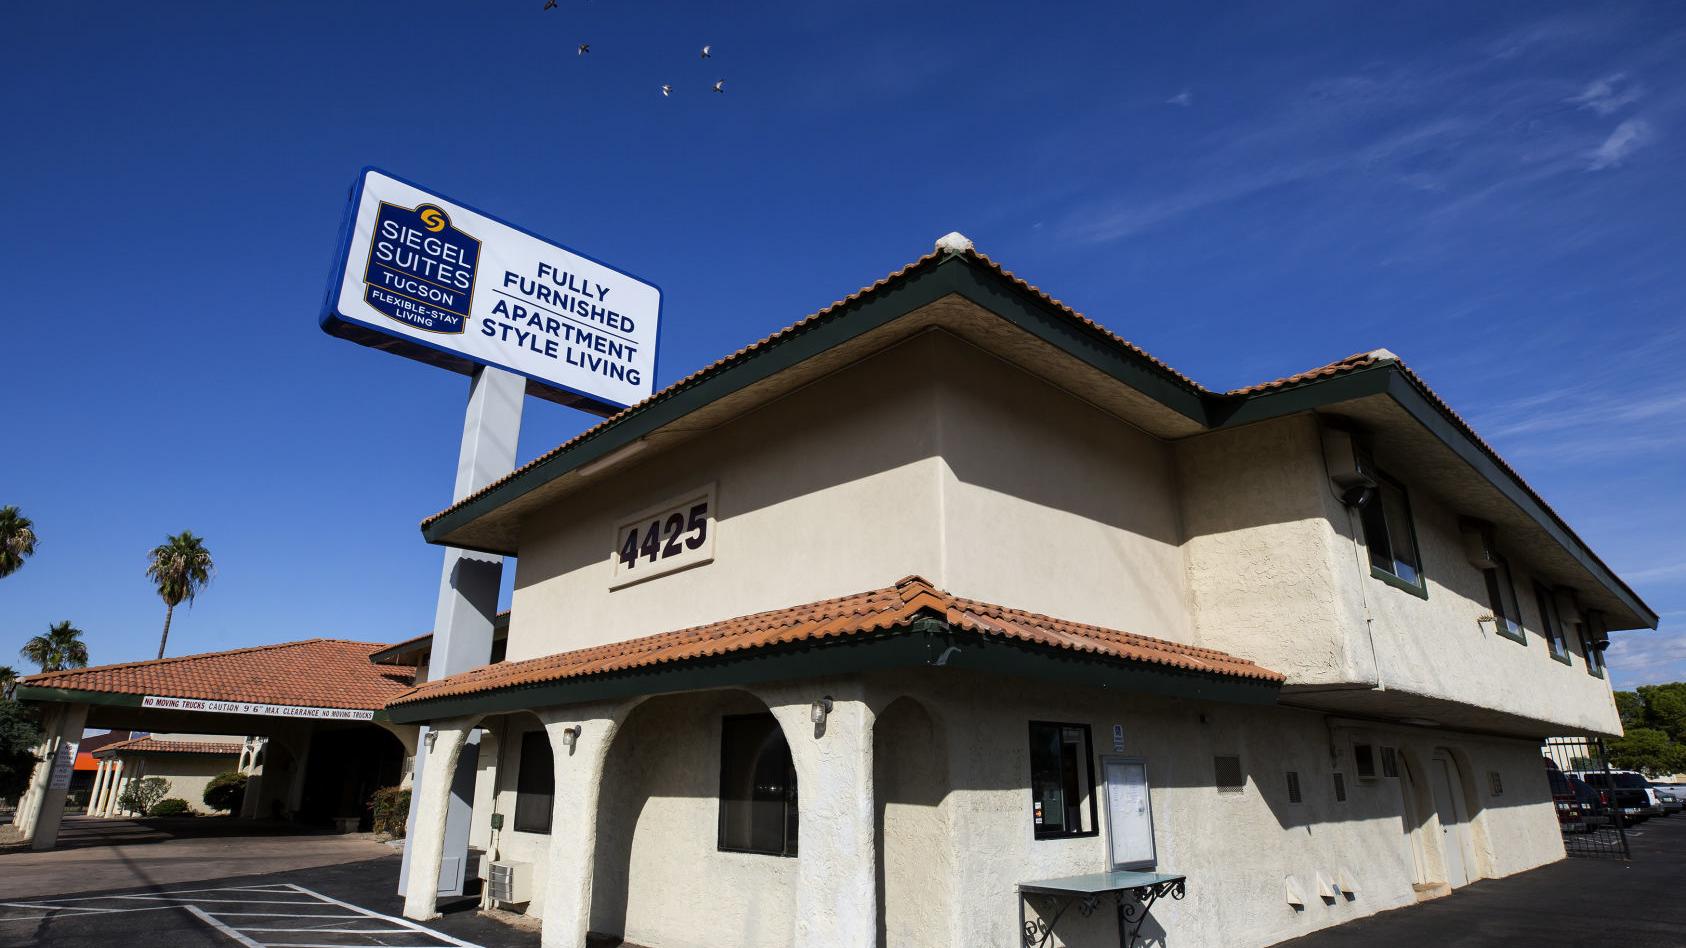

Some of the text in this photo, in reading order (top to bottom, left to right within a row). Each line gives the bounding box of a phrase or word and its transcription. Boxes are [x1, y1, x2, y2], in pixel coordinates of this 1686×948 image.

[376, 241, 470, 289] SUITES
[381, 220, 471, 269] SIEGEL
[383, 271, 454, 306] TUCSON
[503, 270, 635, 334] FURNISHED
[537, 261, 611, 302] FULLY
[372, 290, 459, 325] FLEXIBLE-STAY
[395, 308, 433, 327] LIVING
[491, 299, 638, 363] APARTMENT
[480, 317, 641, 386] STYLE LIVING
[619, 502, 708, 569] 4425
[144, 698, 153, 706] NO
[155, 699, 179, 708] MOVING
[182, 701, 206, 710] TRUCKS
[208, 703, 240, 712] CAUTION
[282, 707, 320, 717] CLEARANCE
[321, 709, 330, 717] NO
[332, 710, 351, 718] MOVING
[353, 711, 373, 719] TRUCKS
